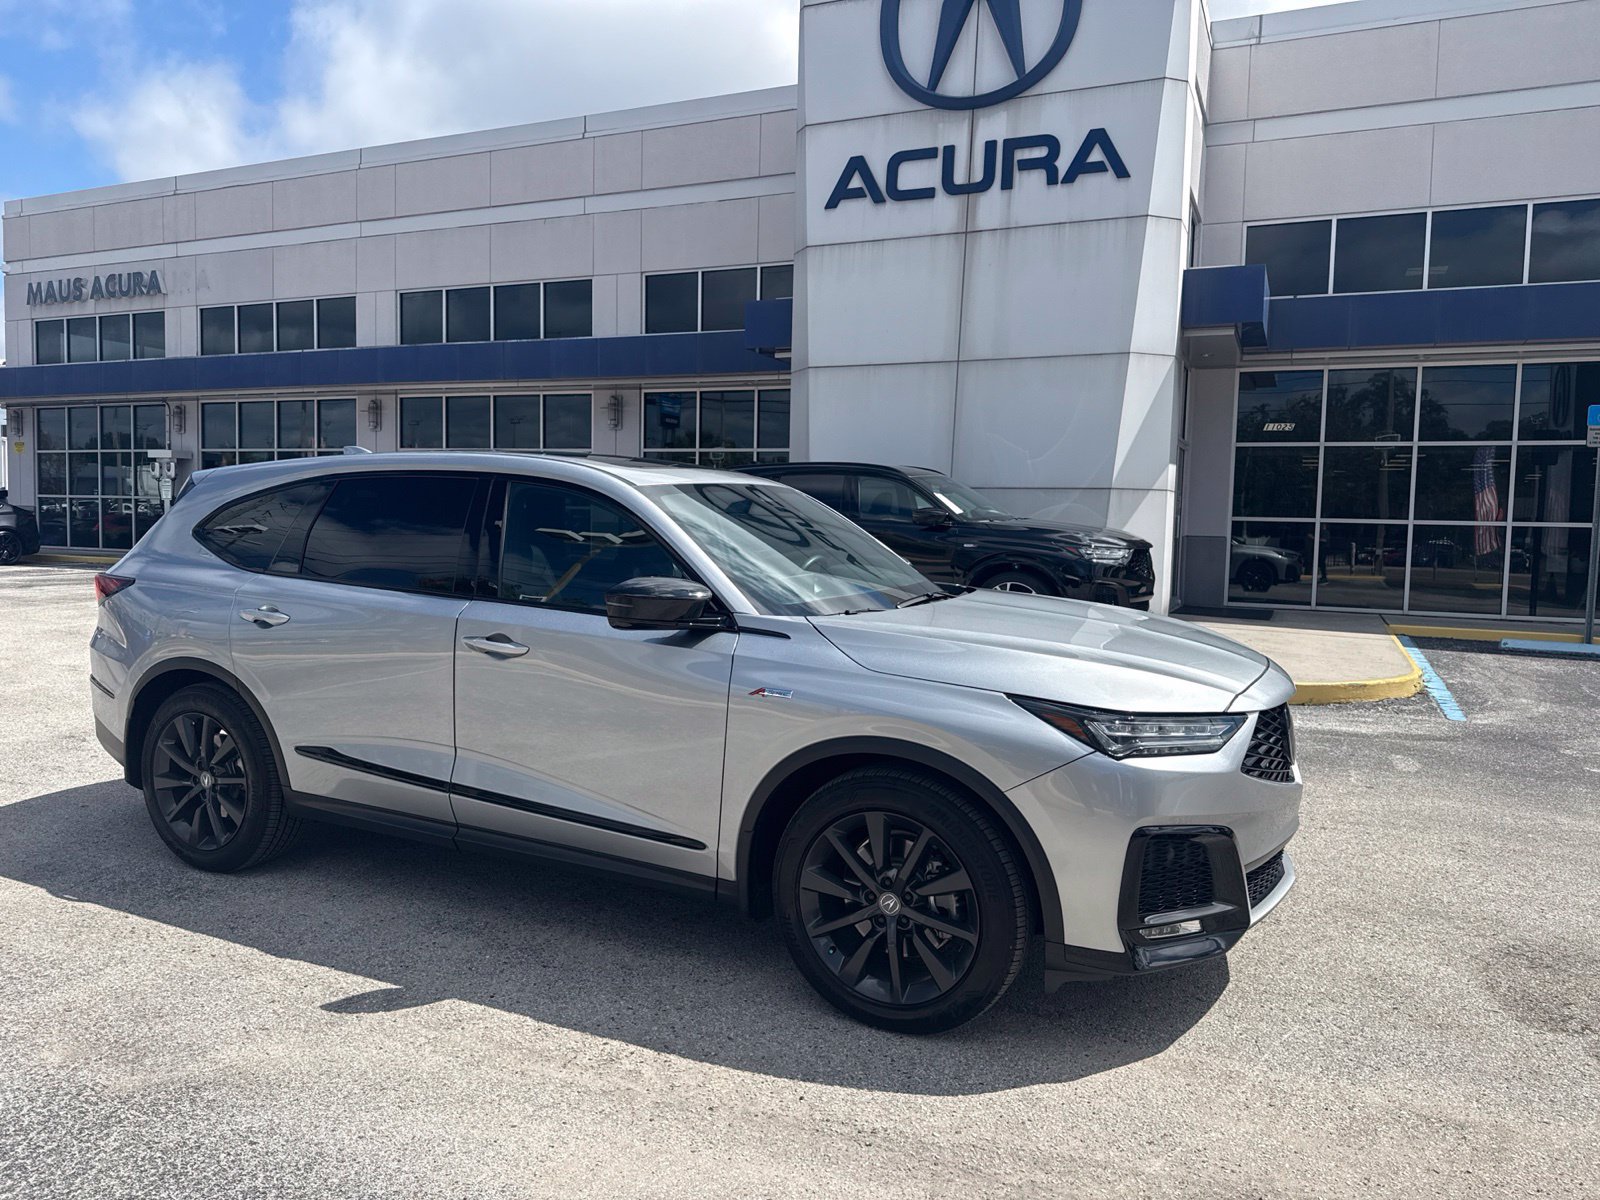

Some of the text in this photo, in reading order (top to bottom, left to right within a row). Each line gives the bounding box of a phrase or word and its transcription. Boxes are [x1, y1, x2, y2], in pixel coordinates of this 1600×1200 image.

[825, 127, 1131, 210] ACURA
[26, 270, 164, 306] MAUS ACURA
[1265, 423, 1293, 431] 11025
